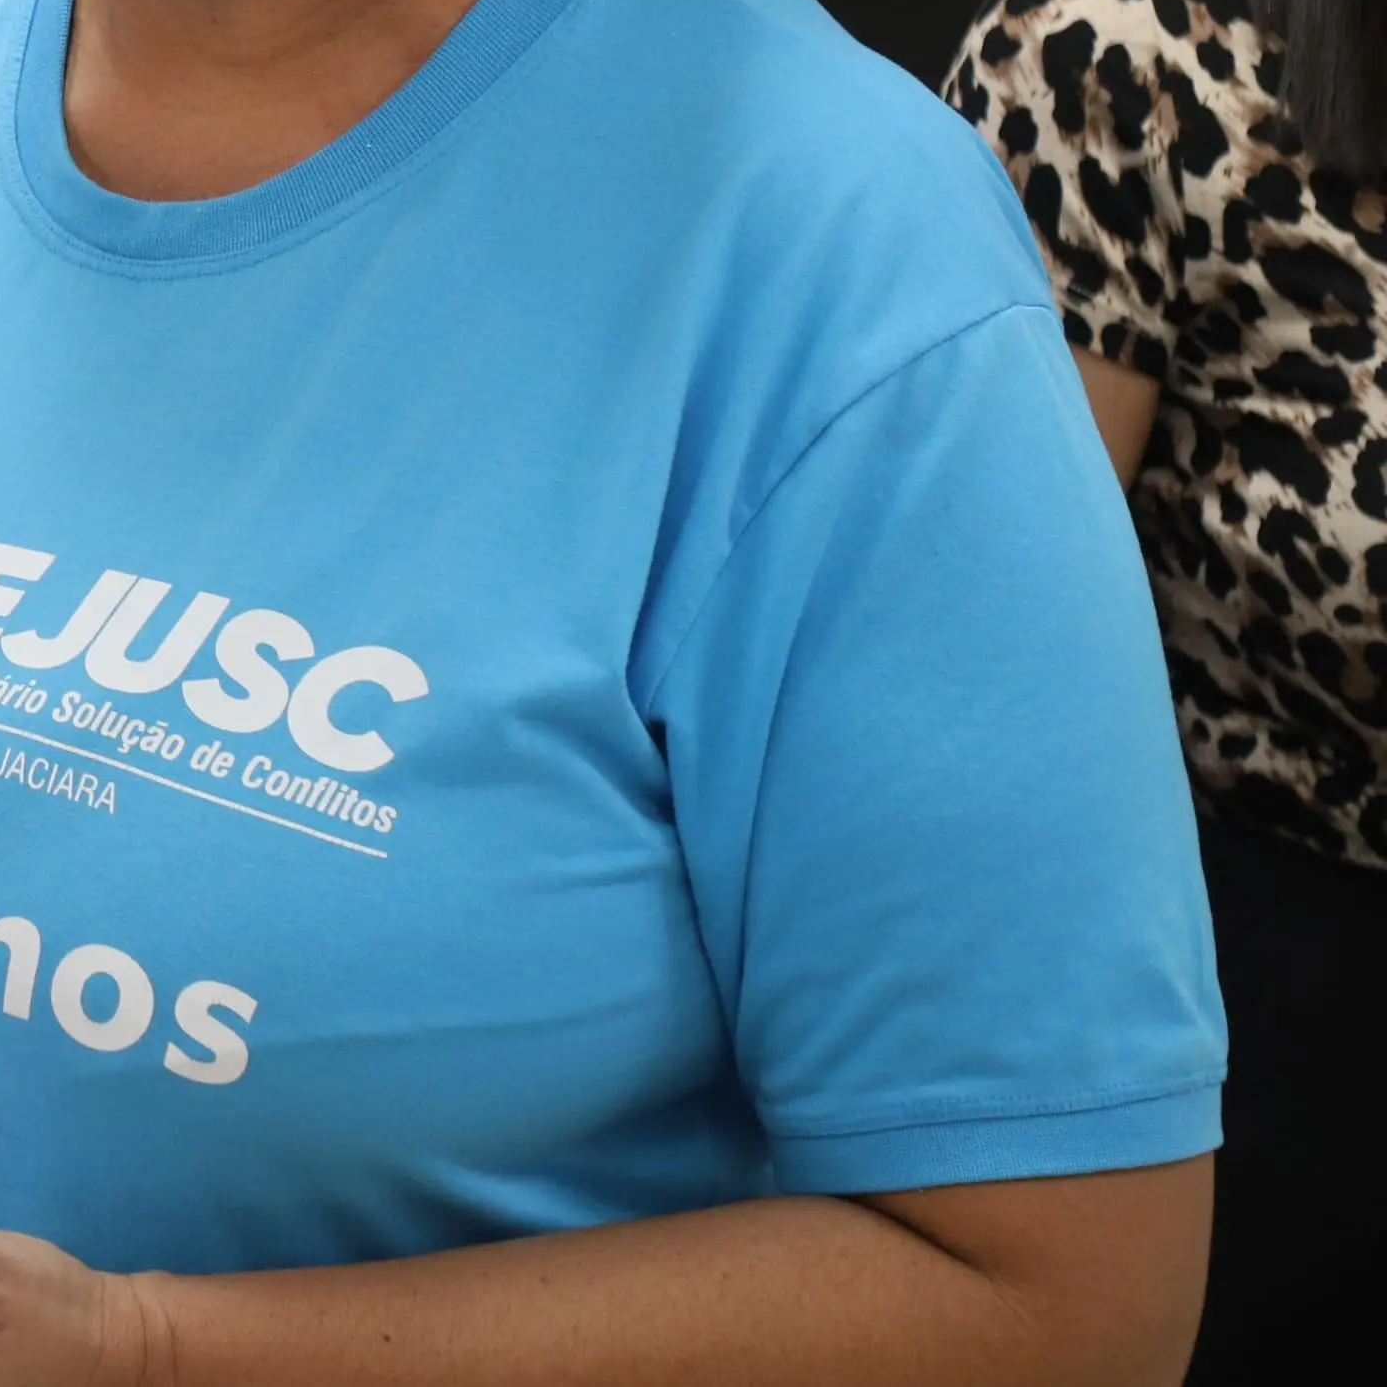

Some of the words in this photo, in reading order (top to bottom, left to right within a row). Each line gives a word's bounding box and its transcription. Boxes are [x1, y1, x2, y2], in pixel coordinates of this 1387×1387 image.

[52, 690, 185, 761] Solução
[190, 740, 235, 778] de
[242, 755, 397, 833] Conflitos
